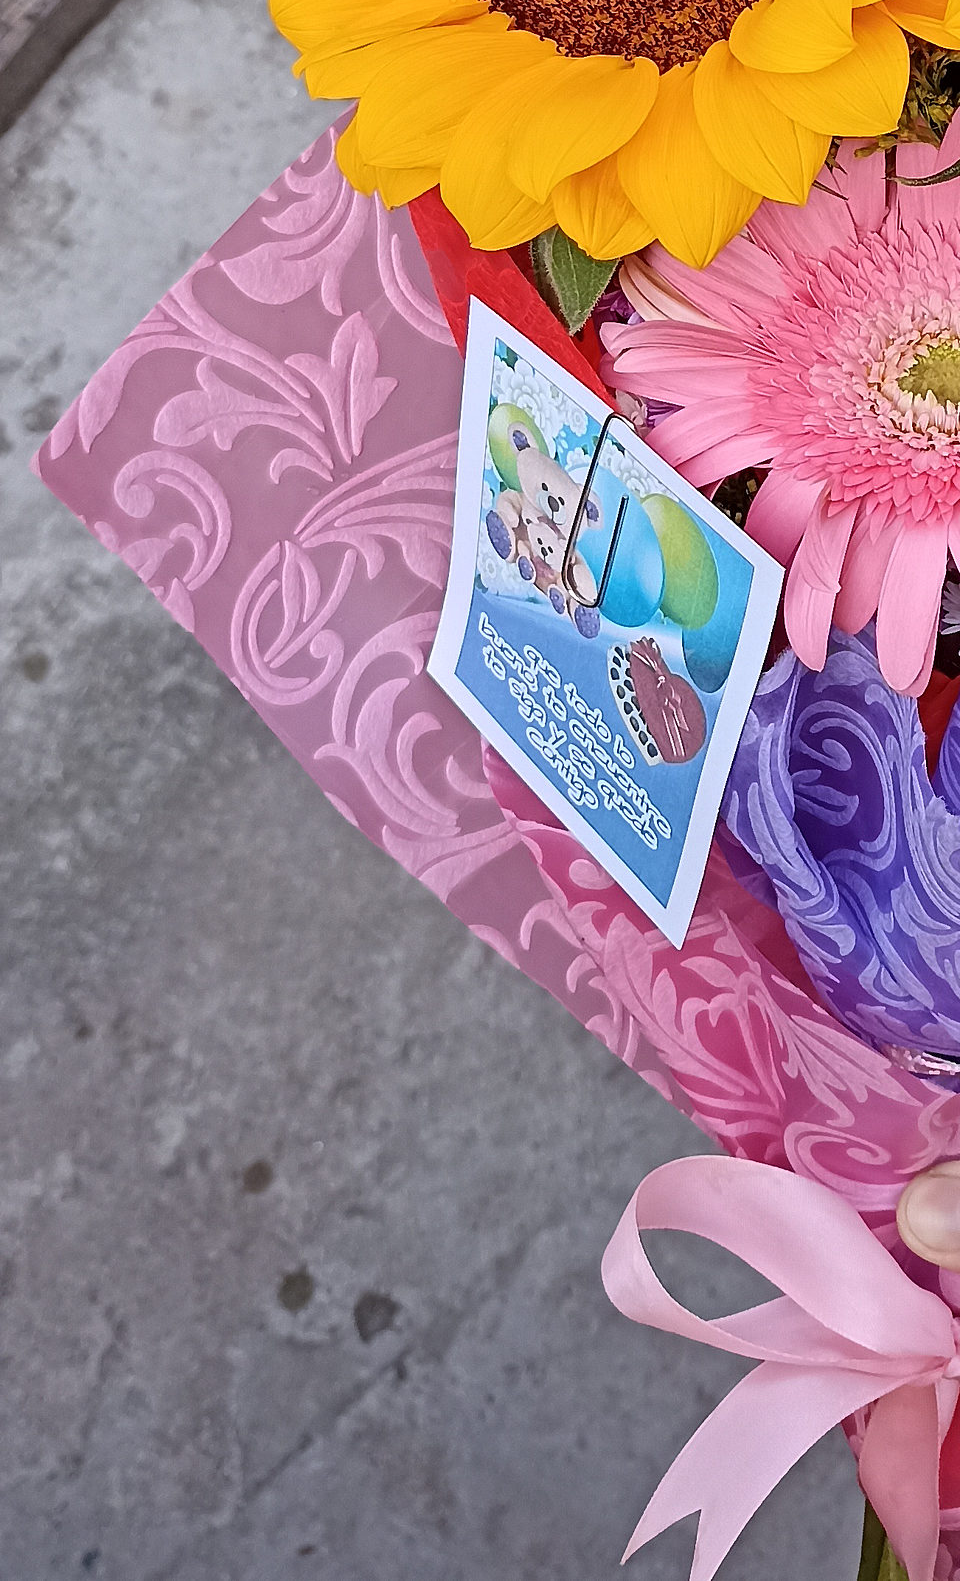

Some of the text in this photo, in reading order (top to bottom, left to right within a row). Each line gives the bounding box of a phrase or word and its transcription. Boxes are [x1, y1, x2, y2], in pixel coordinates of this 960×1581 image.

[483, 646, 505, 680] te
[509, 678, 546, 727] siga
[569, 744, 596, 779] se
[598, 780, 657, 849] quede
[524, 645, 634, 768] que todo lo
[526, 726, 598, 809] contigo
[543, 684, 567, 721] te
[570, 719, 672, 839] encuentre
